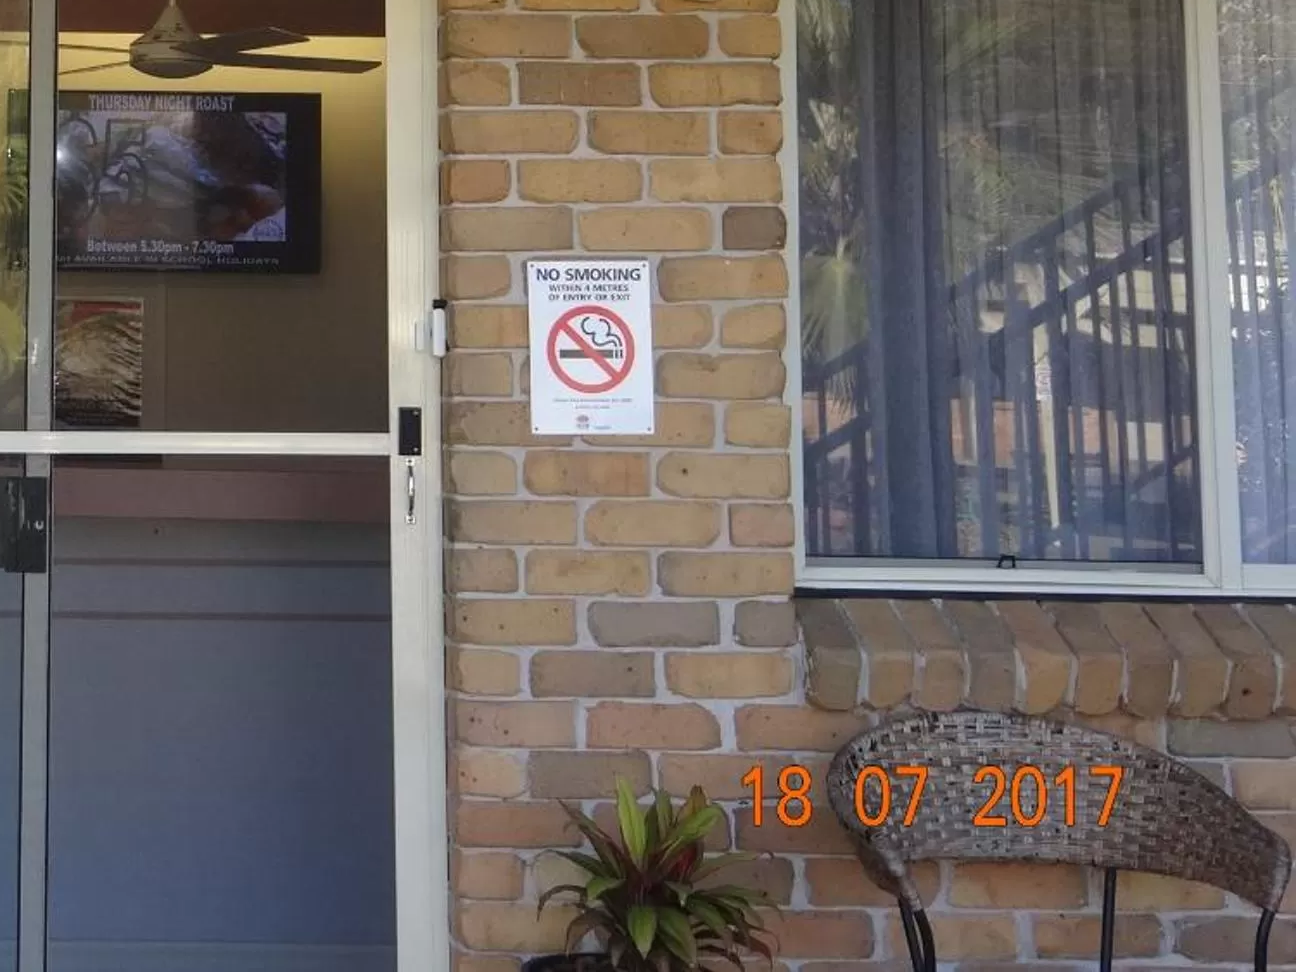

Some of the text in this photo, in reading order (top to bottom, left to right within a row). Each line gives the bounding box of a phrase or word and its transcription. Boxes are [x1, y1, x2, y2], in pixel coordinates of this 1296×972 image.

[89, 94, 235, 112] THURSDAY NIGHT ROAST
[87, 239, 137, 253] Between
[140, 240, 183, 255] 5.30pm
[192, 241, 234, 255] 7.30pm
[536, 267, 641, 282] NO SMOKING
[549, 284, 582, 292] WITHIN
[593, 284, 629, 292] METRES
[563, 293, 592, 301] ENTRY
